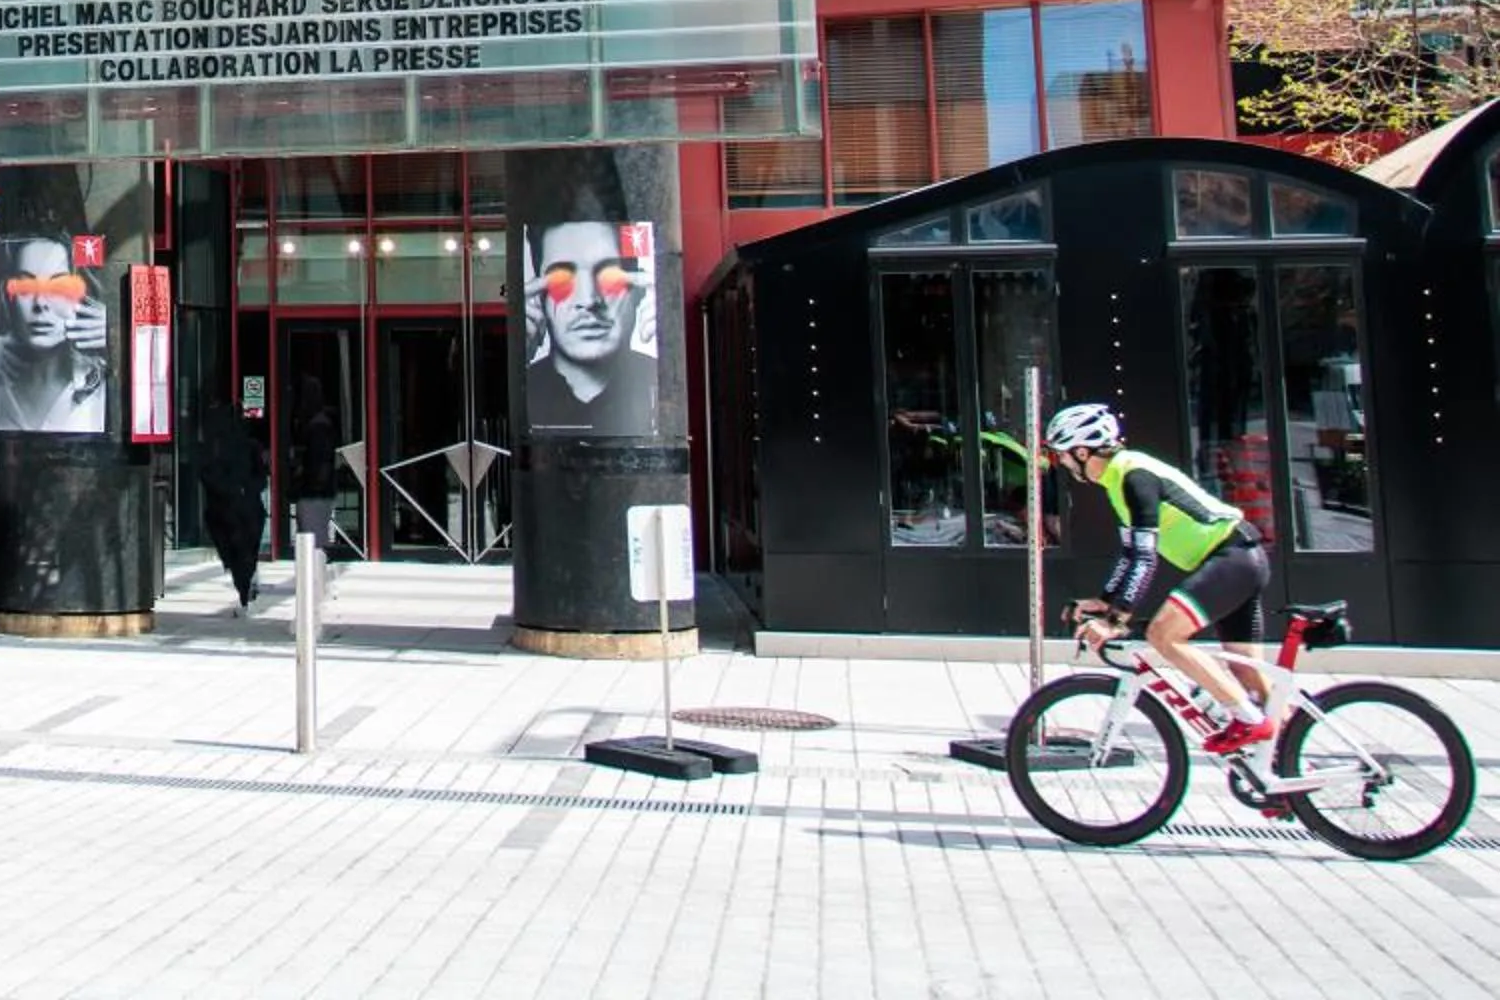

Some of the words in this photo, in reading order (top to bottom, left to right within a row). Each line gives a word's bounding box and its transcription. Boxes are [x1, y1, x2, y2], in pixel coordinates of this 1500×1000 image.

[18, 26, 209, 57] PRESENTATION
[217, 18, 381, 48] DESJARDINS
[392, 8, 582, 40] ENTREPRISES
[76, 1, 153, 26] MARC
[101, 51, 320, 82] COLLABORATION
[330, 50, 363, 73] LA
[374, 45, 481, 71] PRESSE
[1132, 651, 1221, 738] TRE
